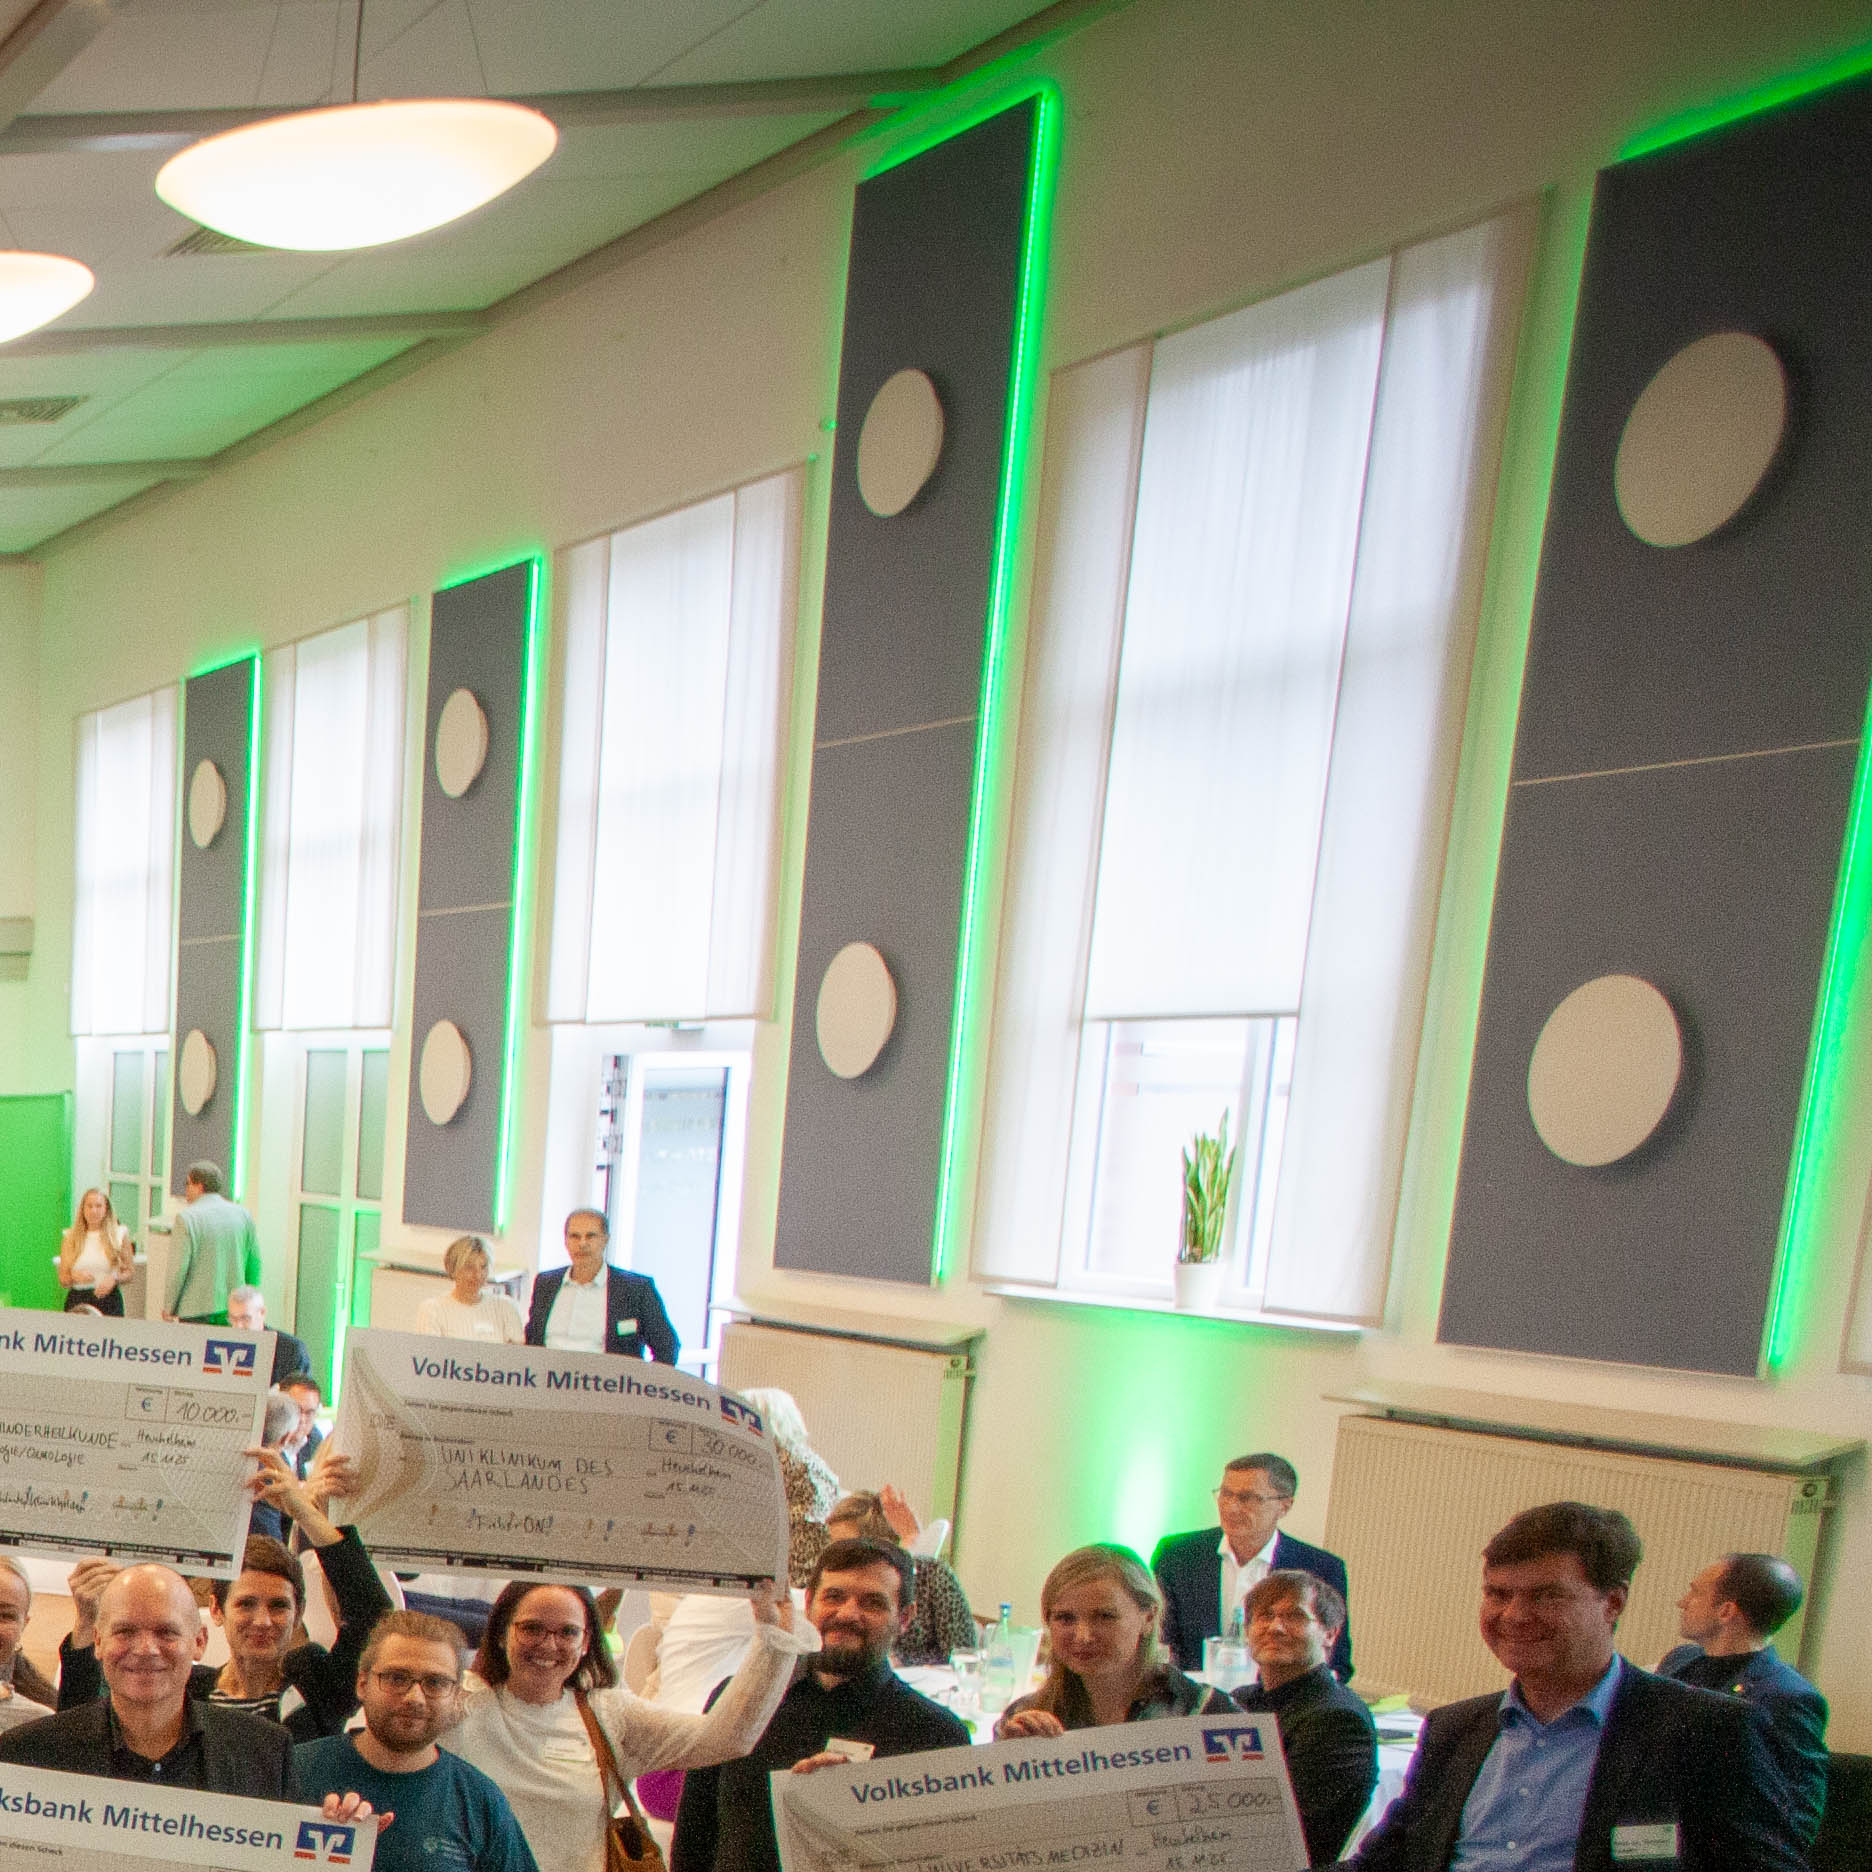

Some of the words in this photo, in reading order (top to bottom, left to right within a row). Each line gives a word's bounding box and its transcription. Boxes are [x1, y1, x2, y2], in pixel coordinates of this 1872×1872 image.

[34, 1333, 191, 1365] Mittelhessen
[412, 1356, 535, 1387] Volksbank
[546, 1370, 710, 1409] Mittelhessen
[140, 1396, 153, 1412] €
[664, 1429, 677, 1444] €
[575, 1457, 613, 1478] DES
[448, 1469, 588, 1498] SAARLANDES
[850, 1766, 994, 1803] Volksbank
[1003, 1745, 1190, 1782] Mittelhessen
[1145, 1798, 1159, 1816] €
[102, 1804, 282, 1848] Mittelhessen
